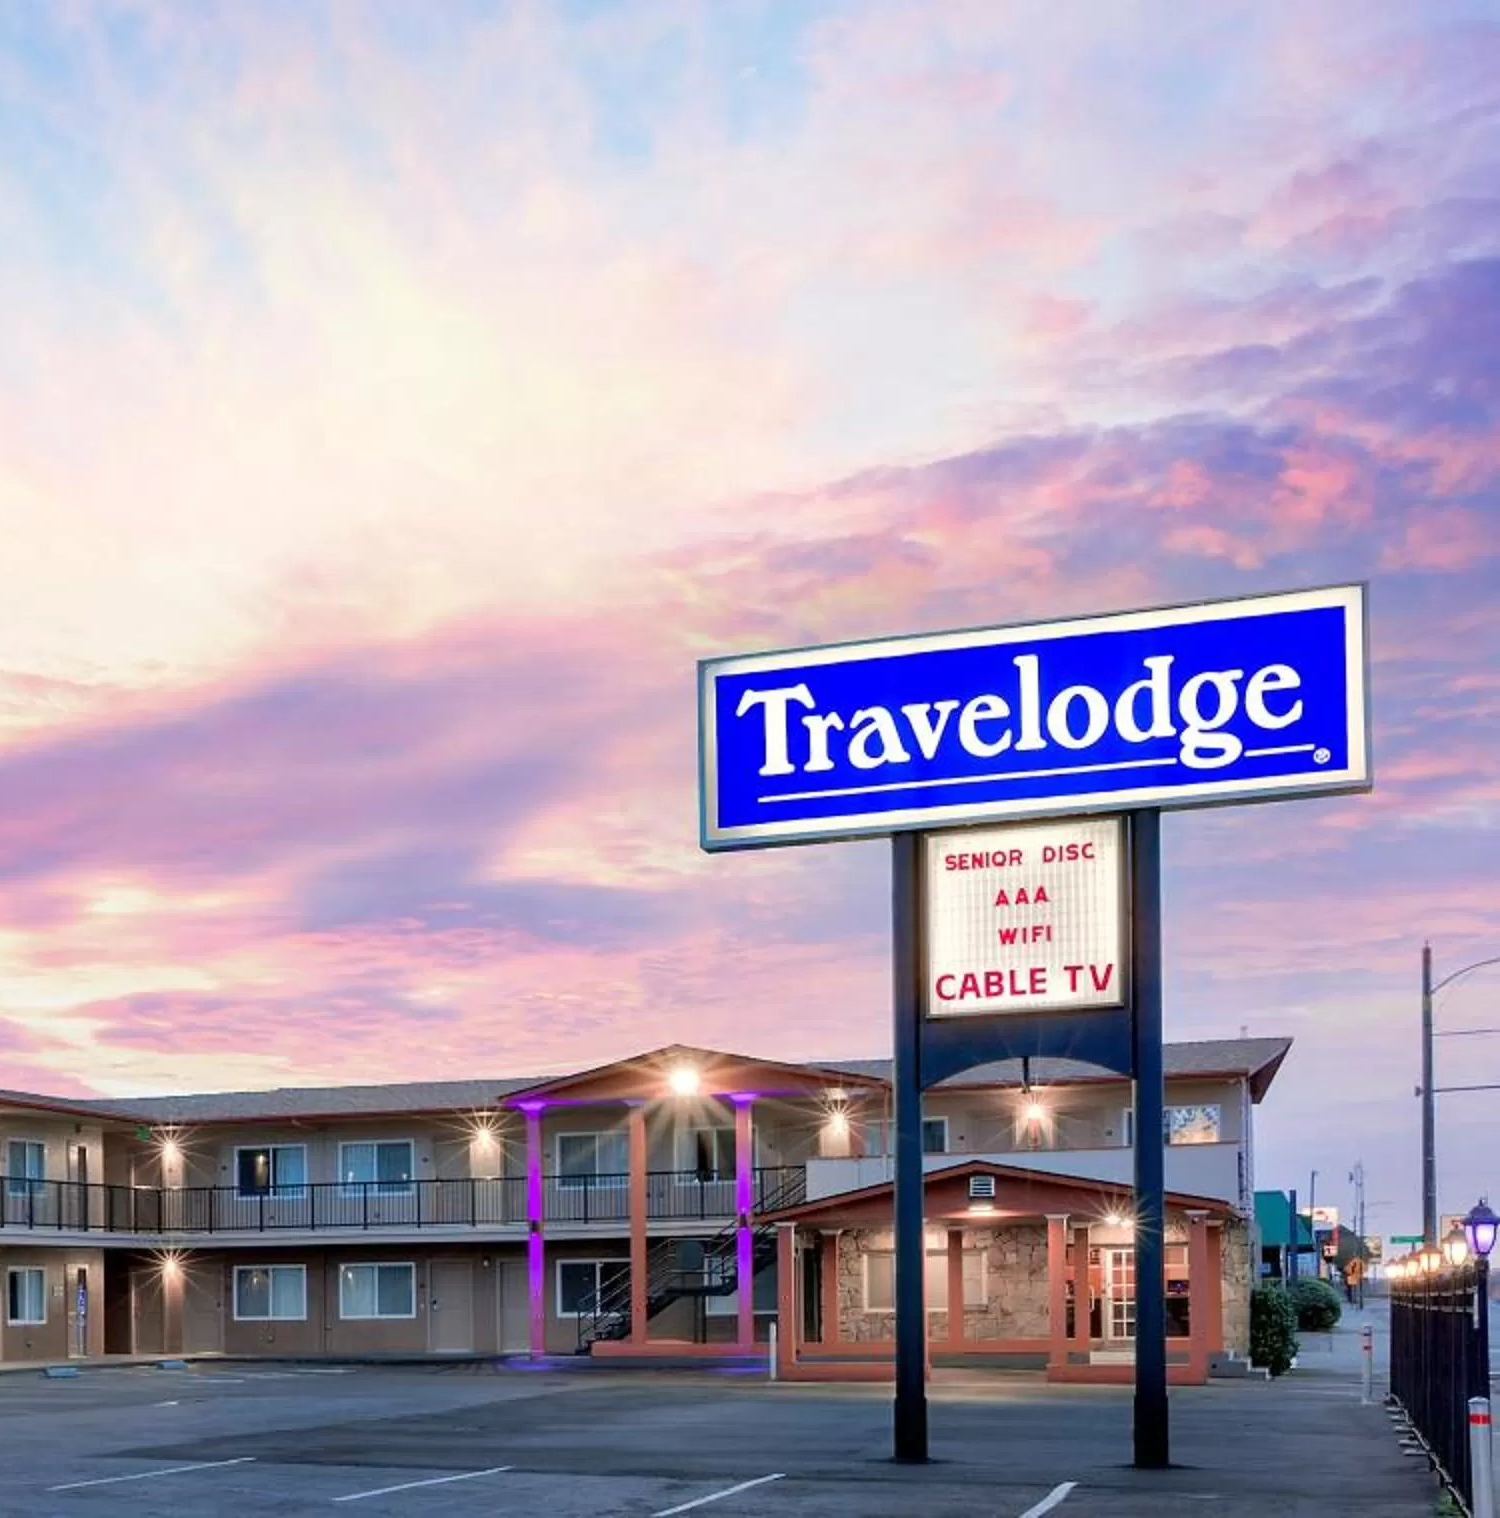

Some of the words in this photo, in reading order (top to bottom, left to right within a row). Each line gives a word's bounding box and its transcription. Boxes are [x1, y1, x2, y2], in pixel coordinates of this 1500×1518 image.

[735, 653, 1304, 777] Travelodge
[944, 849, 1023, 871] SENIOR
[1042, 842, 1095, 863] DISC
[995, 885, 1049, 906] AAA
[998, 925, 1053, 945] WIFI
[935, 967, 1048, 1001] CABLE
[1063, 963, 1113, 993] TV
